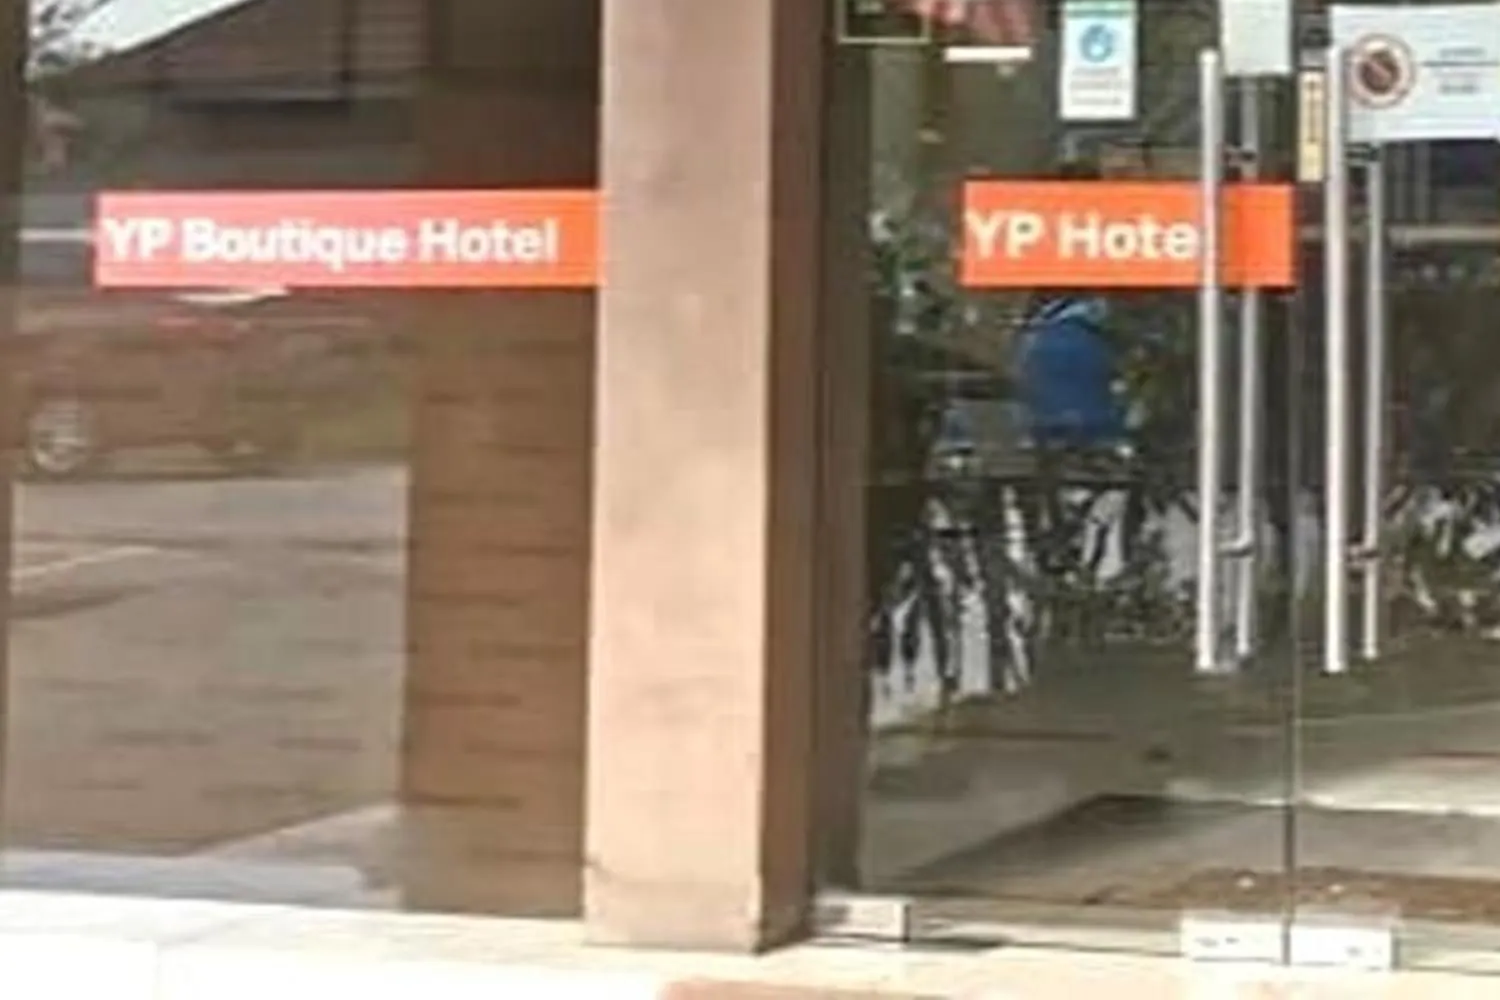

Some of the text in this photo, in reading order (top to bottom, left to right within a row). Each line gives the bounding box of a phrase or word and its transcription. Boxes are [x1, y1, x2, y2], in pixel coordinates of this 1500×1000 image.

[102, 217, 559, 273] YP Boutique Hotel
[964, 207, 1202, 263] YP Hote
